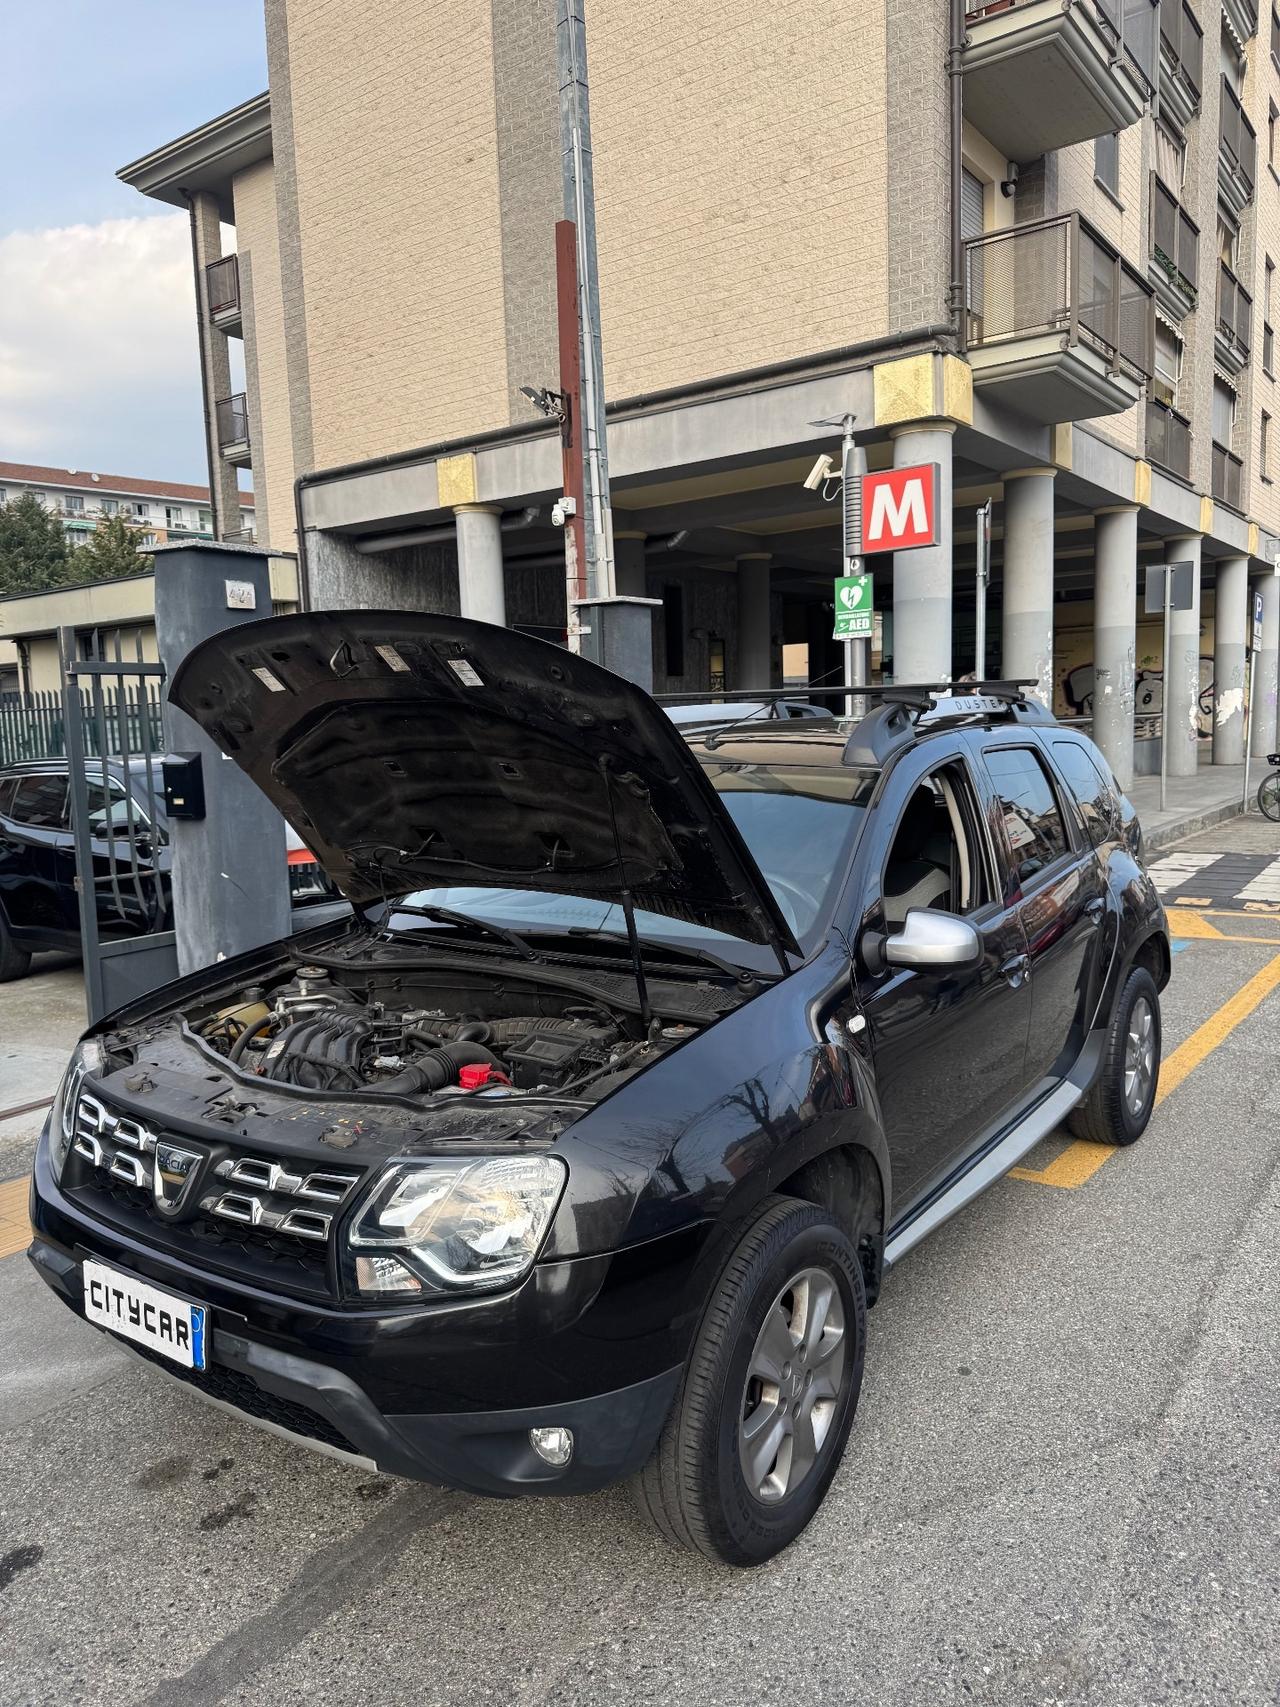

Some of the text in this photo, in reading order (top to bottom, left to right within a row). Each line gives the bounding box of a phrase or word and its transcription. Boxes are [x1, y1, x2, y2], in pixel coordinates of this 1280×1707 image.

[868, 478, 929, 541] M
[1256, 596, 1262, 619] P
[849, 618, 870, 631] AED
[159, 1155, 189, 1173] DACIA
[90, 1279, 189, 1351] CITYCAR
